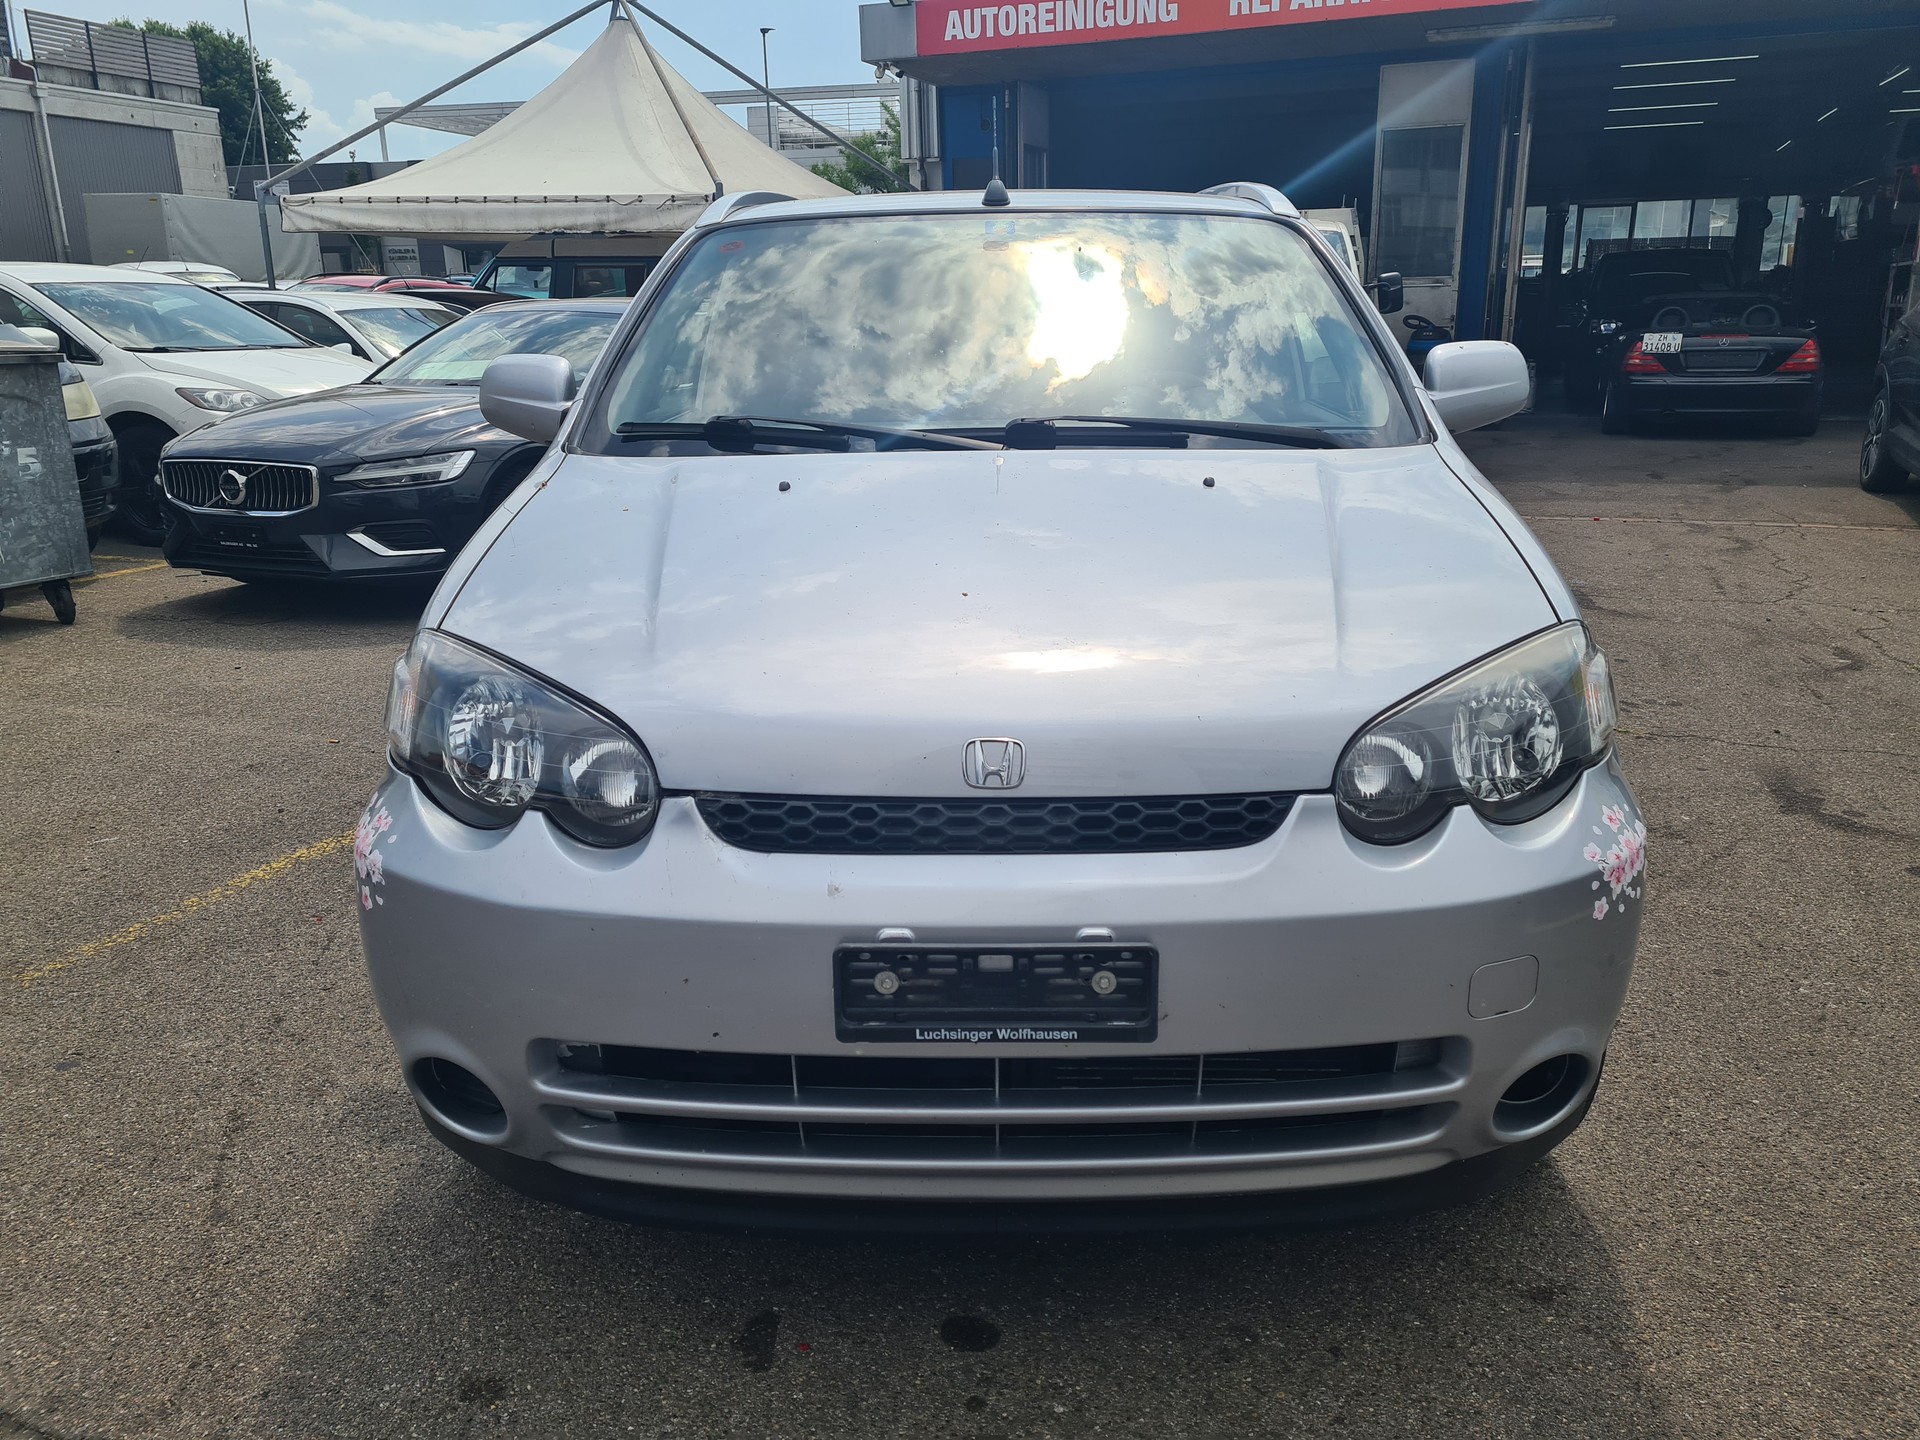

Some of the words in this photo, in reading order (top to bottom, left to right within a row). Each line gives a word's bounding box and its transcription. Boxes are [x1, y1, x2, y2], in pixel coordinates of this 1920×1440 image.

[944, 0, 1178, 41] AUTOREINIGUNG
[1657, 334, 1668, 342] ZH
[1643, 342, 1672, 352] 31408
[915, 1028, 993, 1042] Luchsinger
[996, 1028, 1078, 1040] Wolfhausen
